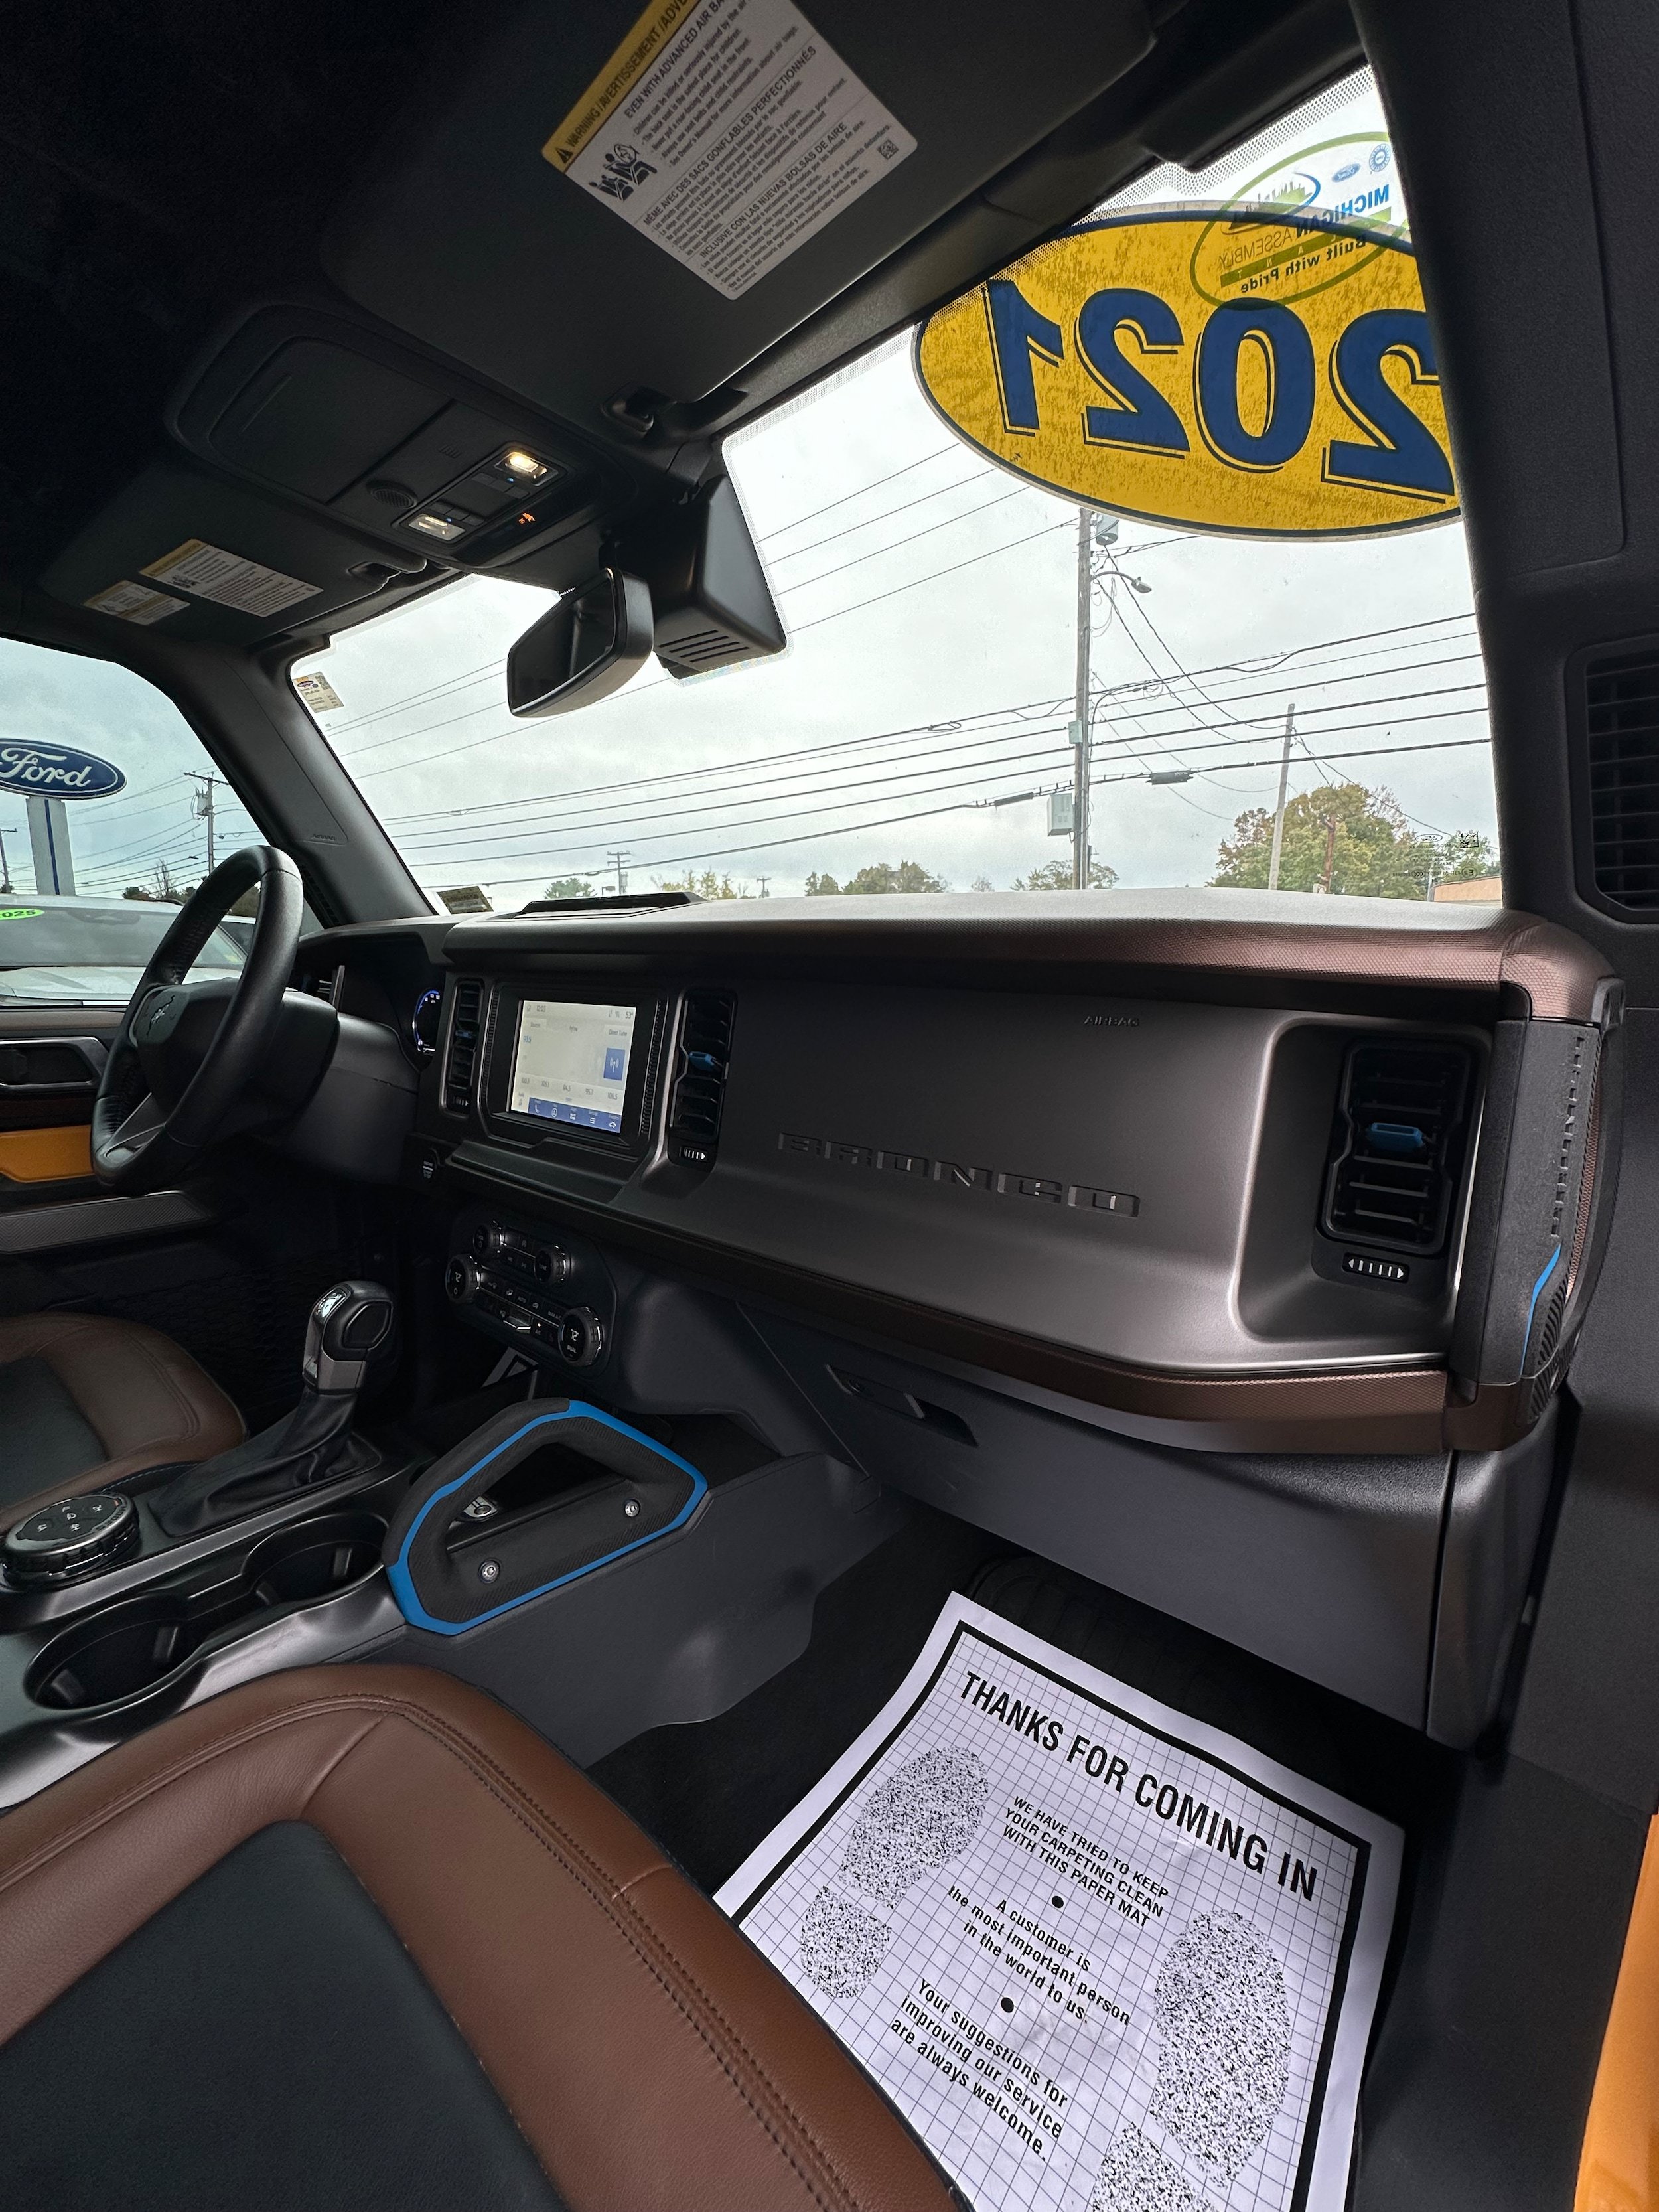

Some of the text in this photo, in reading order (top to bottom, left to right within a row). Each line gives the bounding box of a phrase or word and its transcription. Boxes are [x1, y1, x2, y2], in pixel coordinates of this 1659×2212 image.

[566, 107, 601, 147] WARNING
[599, 27, 660, 109] AVERTISSEMENT
[624, 95, 644, 118] EVEN
[640, 74, 660, 97] WITH
[659, 28, 697, 77] ADVANCED
[696, 10, 711, 30] AIR
[660, 190, 678, 208] AVEC
[676, 175, 691, 192] DES
[685, 157, 709, 179] SACS
[704, 113, 753, 161] GONFLABLES
[751, 46, 815, 114] PERFECTIONNÉS
[699, 122, 847, 258] INCLUSIVE CON LAS NUEVAS BOLSAS DE AIRE
[0, 747, 92, 787] Ford
[1084, 1016, 1139, 1027] AIRBAG
[778, 1132, 1140, 1218] BRONCO
[960, 1671, 1317, 1901] THANKS FOR COMING IN
[1004, 1825, 1150, 1927] WITH THIS PAPER MAT
[1005, 1808, 1163, 1917] YOUR CARPETING CLEAN
[1013, 1796, 1169, 1898] WE HAVE TRIED TO KEEP
[948, 1886, 1129, 2024] the most important person
[964, 1920, 1087, 2023] in the world to us.
[996, 1899, 1090, 1972] A customer is
[891, 2019, 1045, 2161] are always welcome.
[901, 1995, 1062, 2138] improving our service
[919, 1978, 1067, 2108] Your suggestions for
